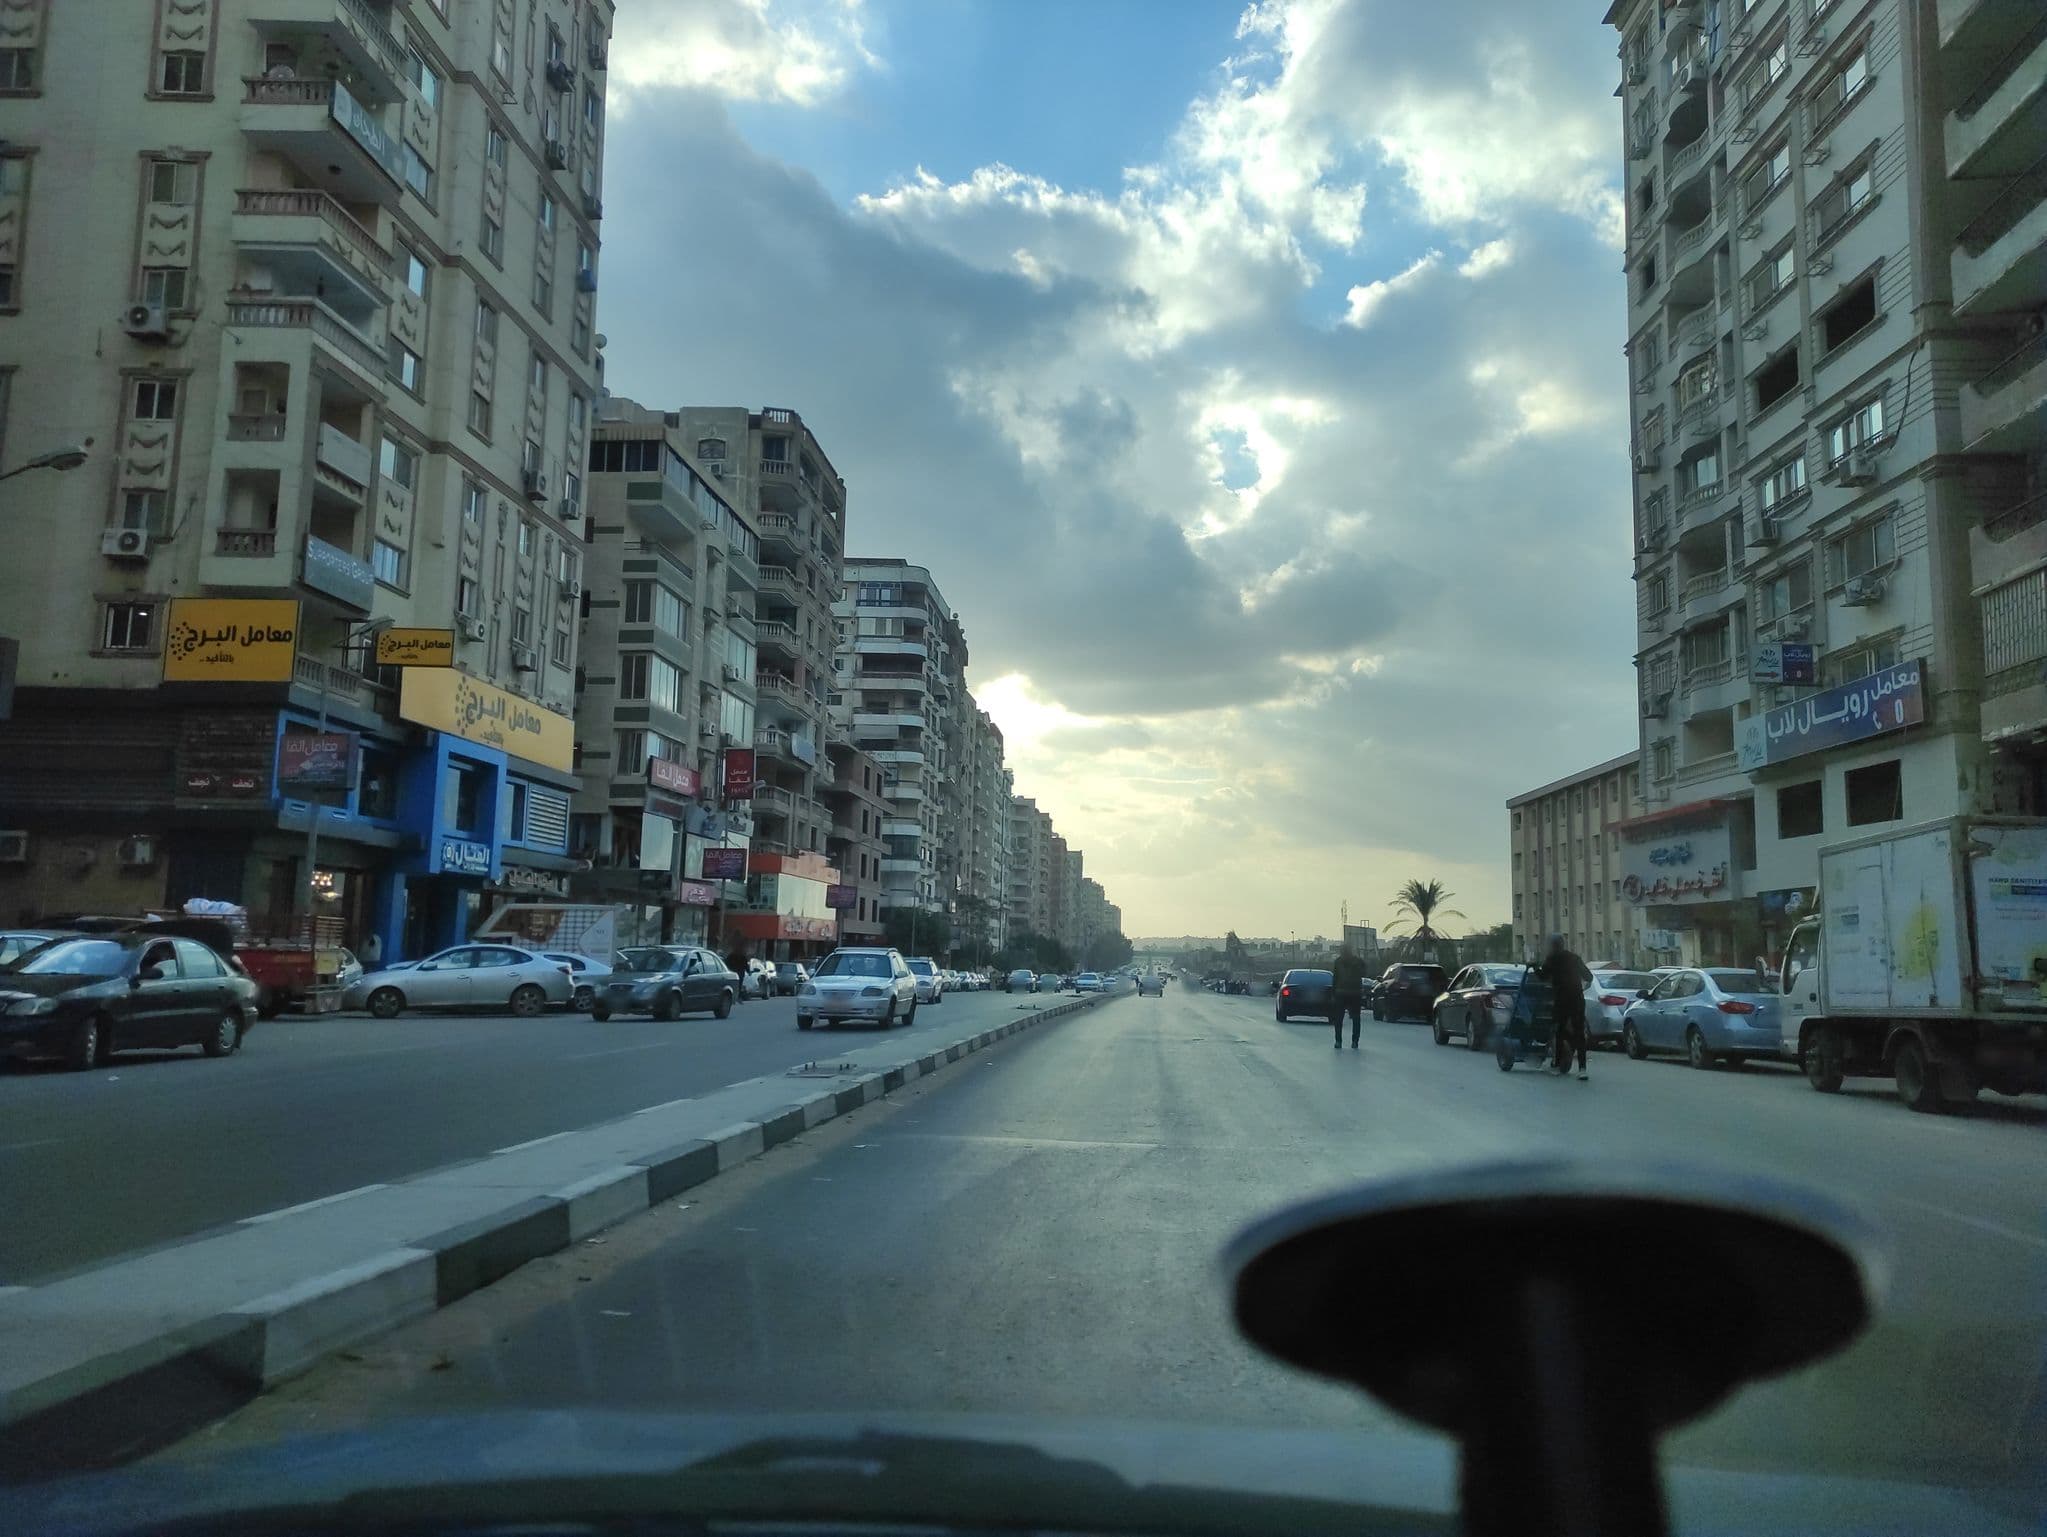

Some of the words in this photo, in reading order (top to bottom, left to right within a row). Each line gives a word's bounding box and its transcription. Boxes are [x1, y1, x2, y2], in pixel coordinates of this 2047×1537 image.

[184, 625, 237, 652] البرج
[240, 625, 293, 647] معامل
[388, 638, 419, 652] البرج
[420, 639, 451, 651] معامل
[1870, 670, 1919, 700] معامل
[465, 689, 506, 727] البرج
[508, 704, 542, 735] معامل
[1798, 688, 1870, 735] رويال
[1767, 706, 1796, 743] لاب
[305, 738, 339, 756] معامل
